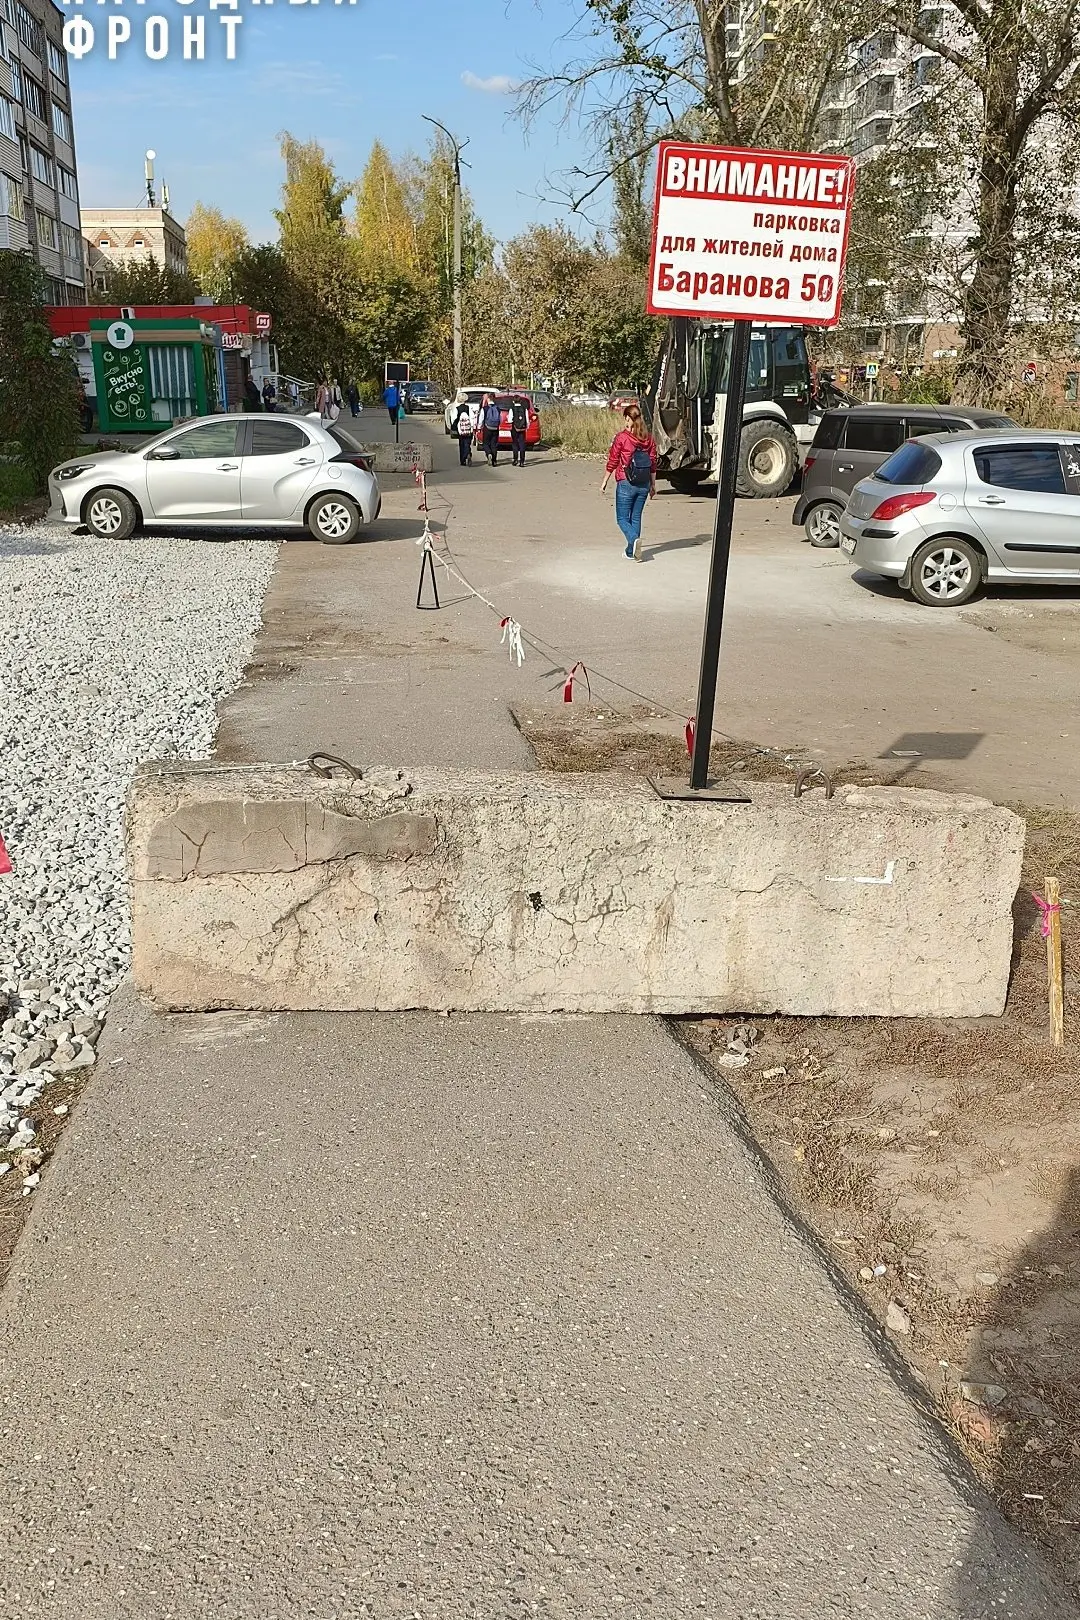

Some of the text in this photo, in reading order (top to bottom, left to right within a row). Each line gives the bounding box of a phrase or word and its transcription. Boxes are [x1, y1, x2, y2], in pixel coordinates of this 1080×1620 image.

[666, 156, 846, 203] ВНИМАНИЕ!
[753, 212, 840, 234] парковка
[660, 235, 837, 263] для жителей дома
[657, 262, 834, 302] Баранова 50
[109, 366, 143, 386] Вкусно
[114, 377, 138, 395] есть!
